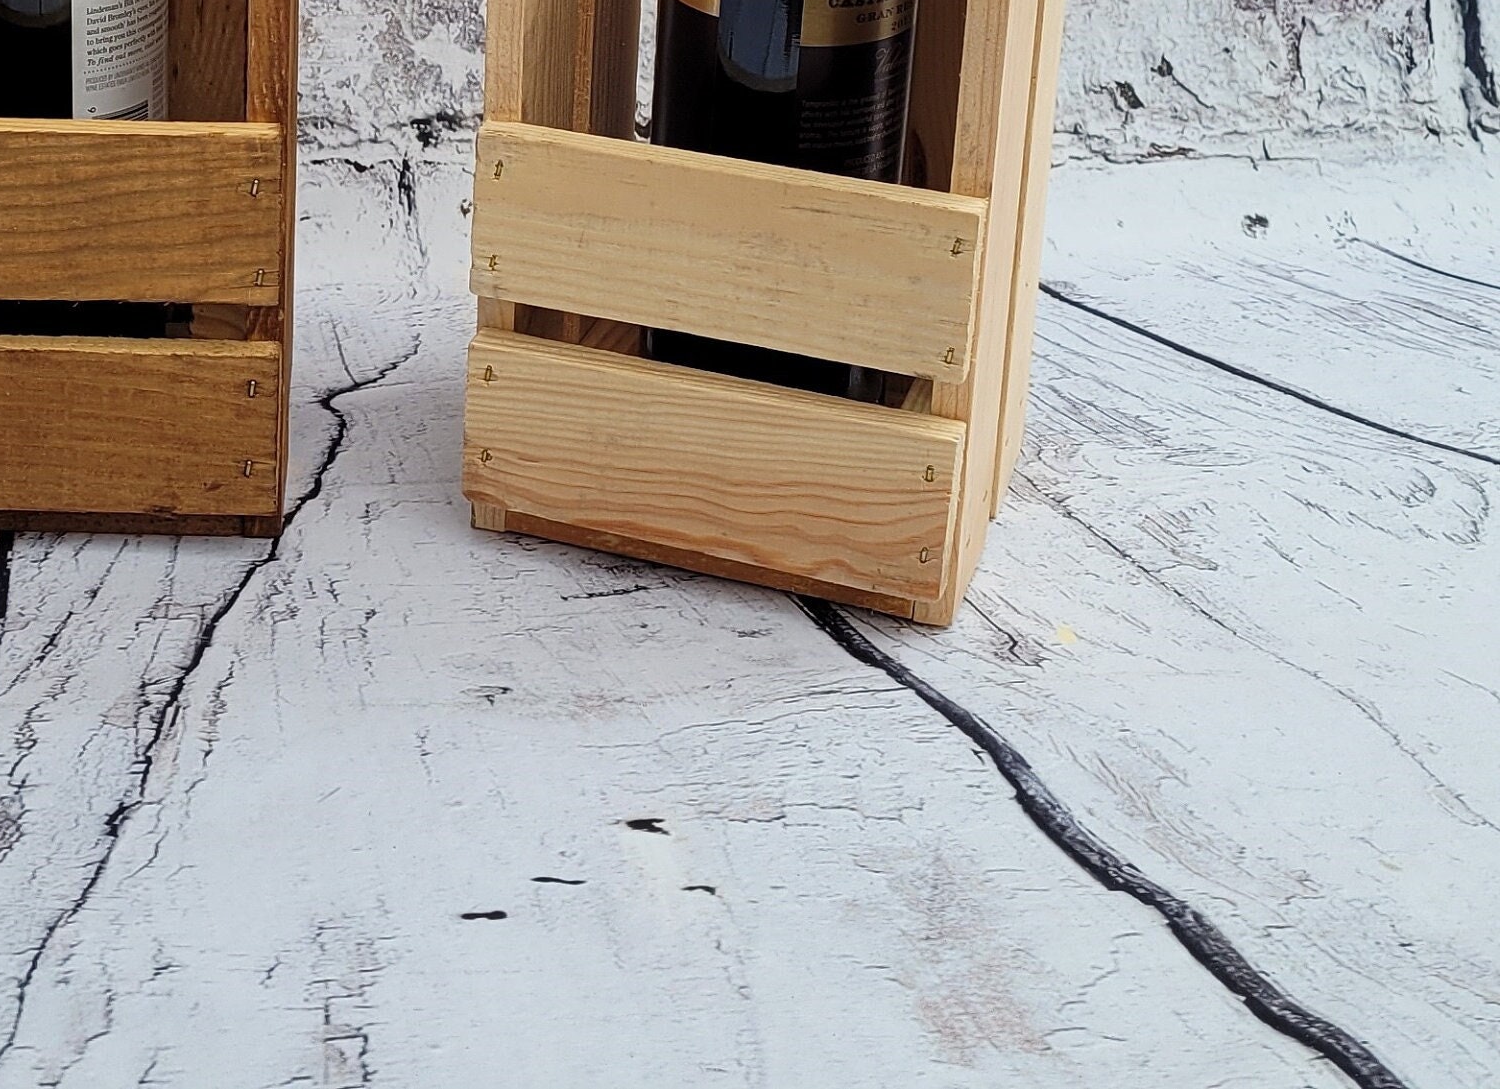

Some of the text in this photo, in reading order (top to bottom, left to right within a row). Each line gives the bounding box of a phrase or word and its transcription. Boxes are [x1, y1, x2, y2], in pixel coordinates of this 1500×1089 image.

[87, 15, 107, 26] David
[856, 7, 894, 24] GRAN
[87, 27, 100, 36] and
[87, 39, 95, 47] to
[96, 34, 114, 46] bring
[114, 31, 126, 43] you
[87, 45, 108, 56] which
[88, 58, 97, 67] To
[97, 54, 114, 67] find
